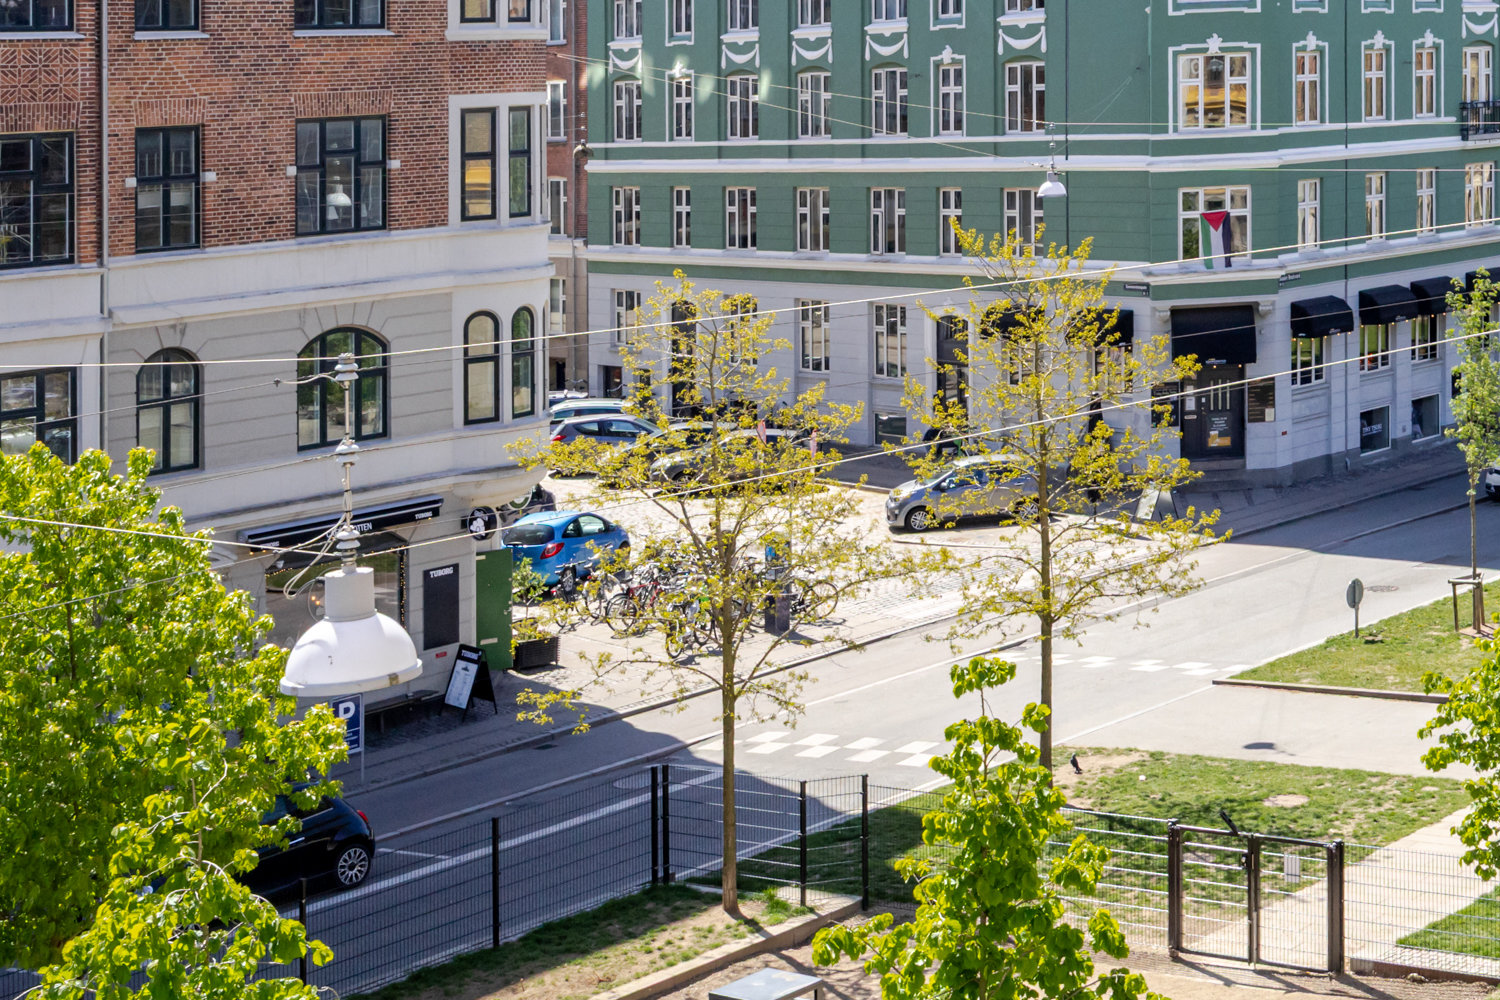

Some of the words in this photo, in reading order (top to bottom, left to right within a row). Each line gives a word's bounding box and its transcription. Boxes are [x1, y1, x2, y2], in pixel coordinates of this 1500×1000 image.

[415, 511, 433, 520] TUBORG
[430, 566, 454, 578] TUBORG
[339, 701, 355, 719] P
